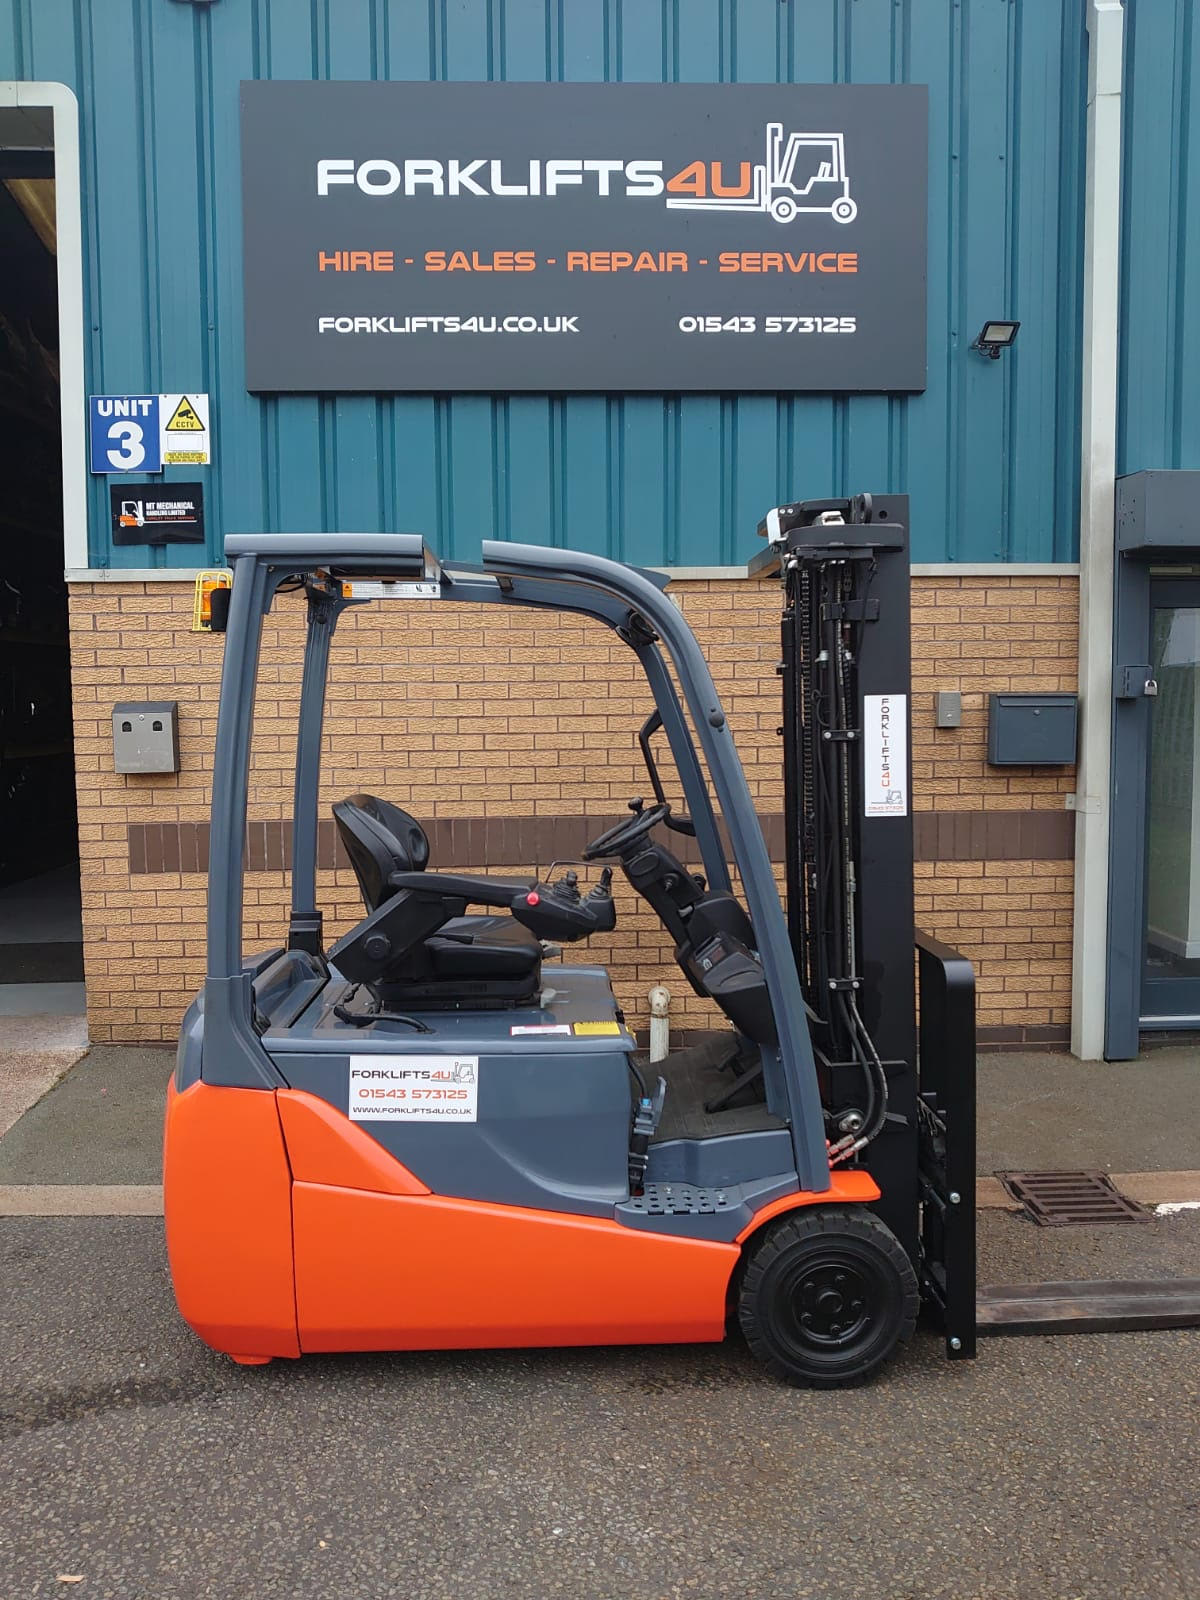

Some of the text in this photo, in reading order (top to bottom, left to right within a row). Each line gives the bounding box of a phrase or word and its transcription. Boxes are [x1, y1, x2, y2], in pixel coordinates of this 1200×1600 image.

[316, 159, 752, 198] FORKLIFTS4U
[318, 250, 394, 273] HIRE
[425, 250, 537, 273] SALES
[567, 251, 689, 273] REPAIR
[719, 251, 858, 274] SERVICE
[318, 316, 580, 334] FORKLIFTS4U.CO.UK
[678, 316, 857, 333] 01543 573125
[97, 399, 153, 417] UNIT
[175, 421, 195, 429] CCTV
[106, 420, 146, 470] 3
[156, 501, 196, 510] MECHANICAL
[880, 697, 891, 788] FORKLIFTS4U
[351, 1069, 452, 1080] FORKLIFTS4U
[358, 1088, 468, 1100] 01543 573125
[352, 1106, 472, 1115] WWW.FORKLIFTS4U.CO.UK
